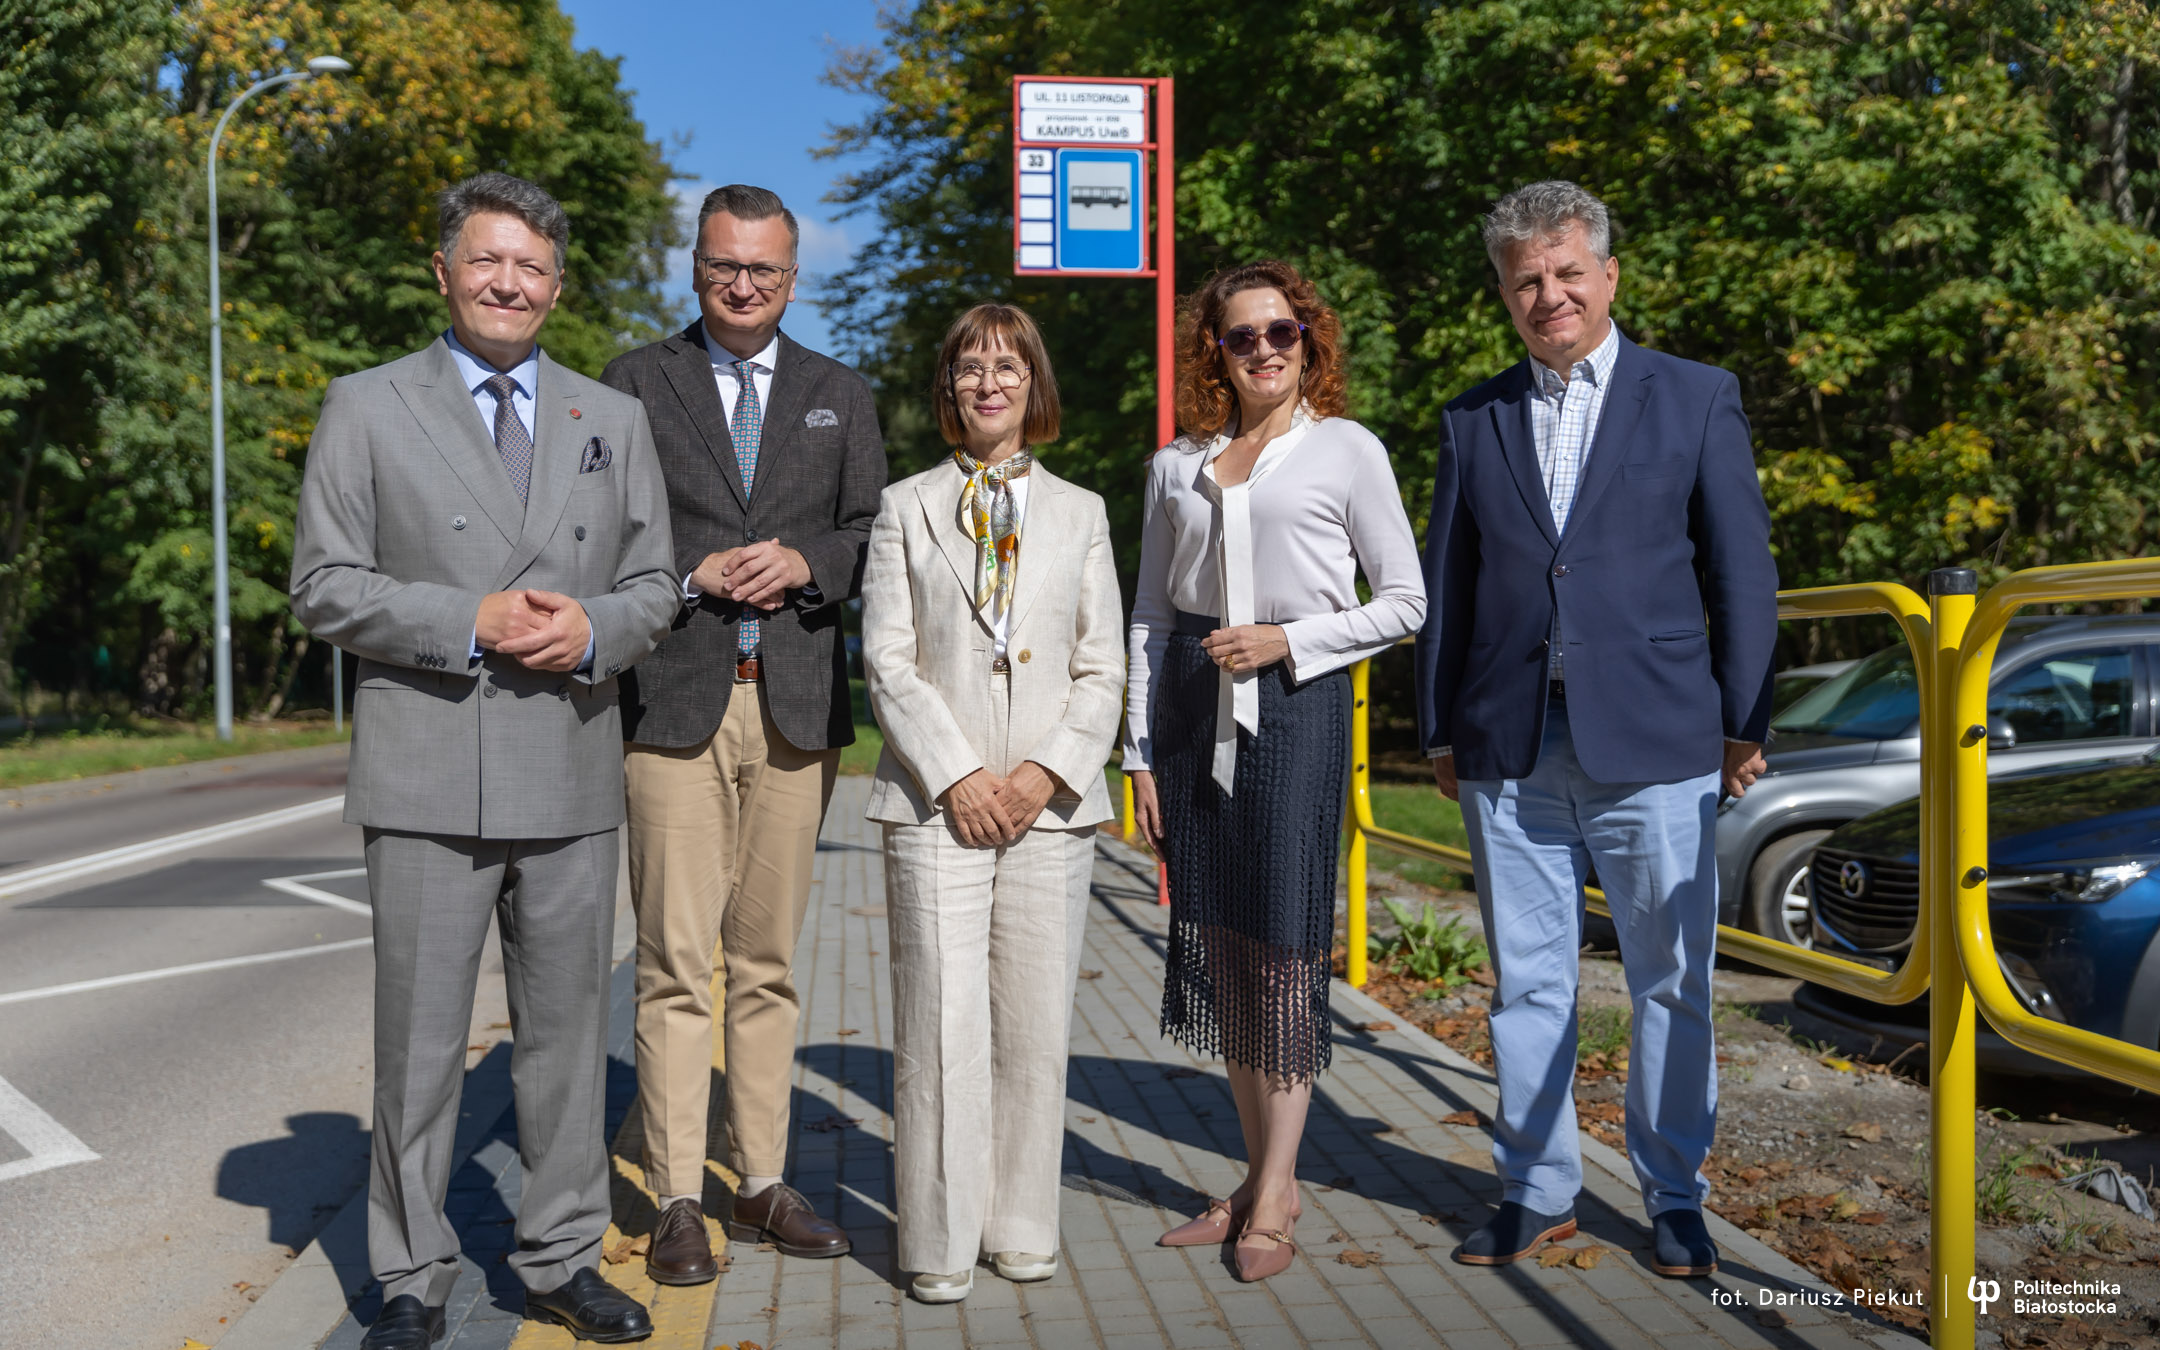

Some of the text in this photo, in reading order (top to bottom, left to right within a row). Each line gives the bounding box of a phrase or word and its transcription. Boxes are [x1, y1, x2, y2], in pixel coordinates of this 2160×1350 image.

[1056, 92, 1068, 103] 11
[1071, 93, 1131, 103] LISTOPADA
[1036, 125, 1130, 138] KAMPUS UwB
